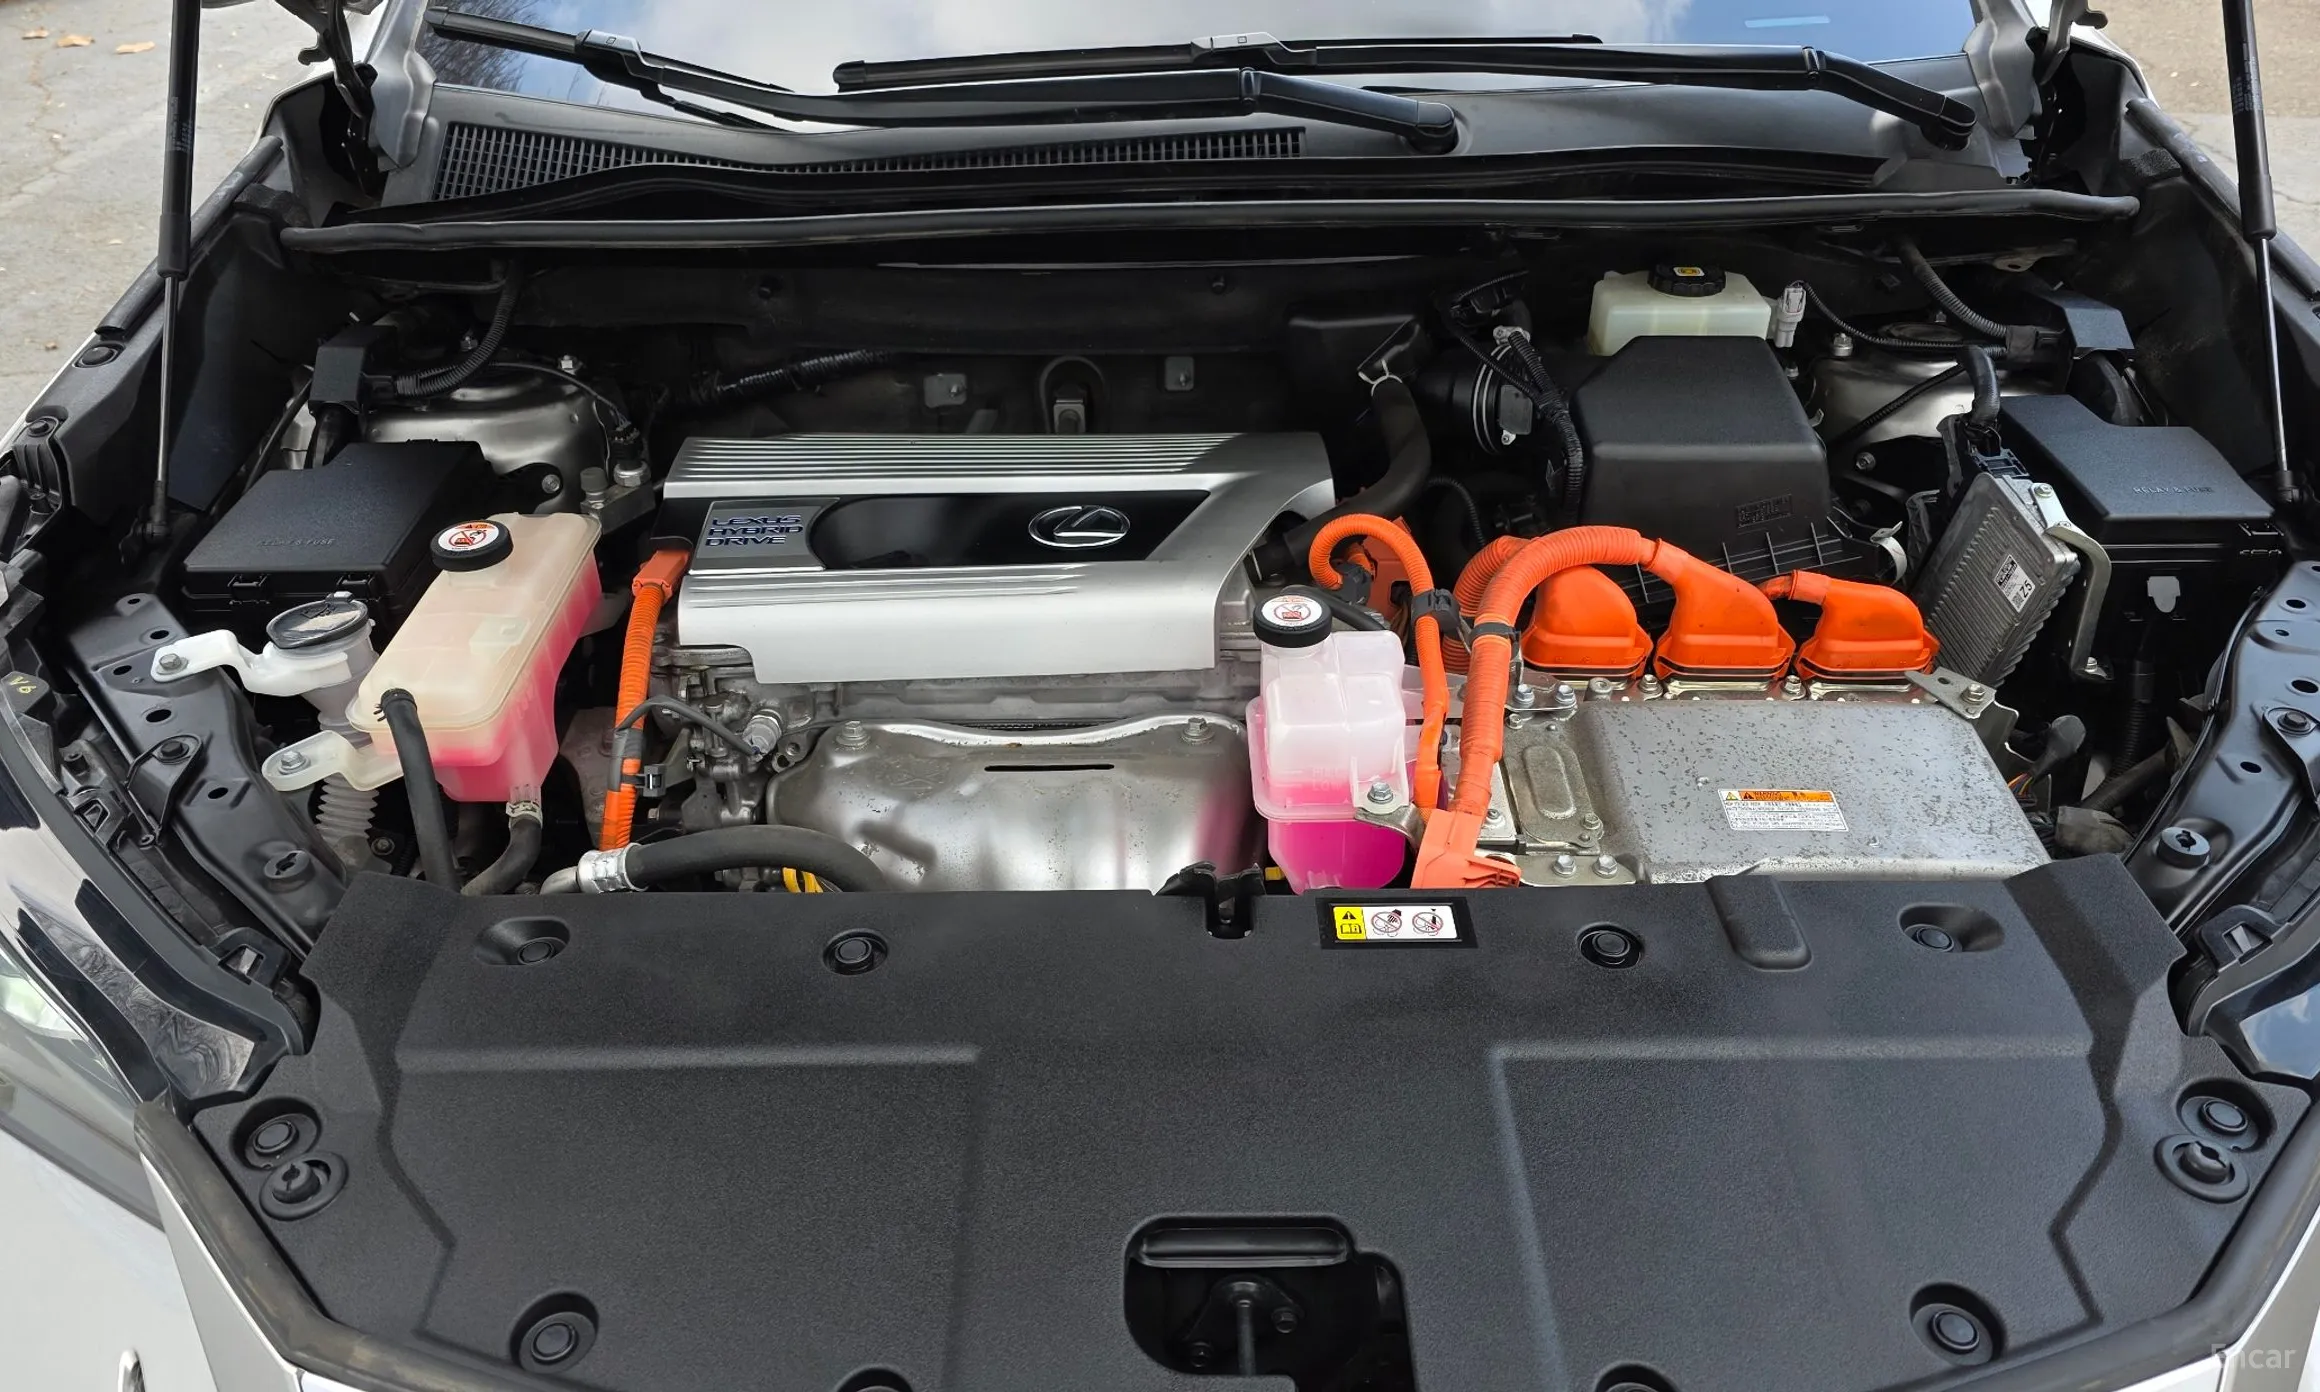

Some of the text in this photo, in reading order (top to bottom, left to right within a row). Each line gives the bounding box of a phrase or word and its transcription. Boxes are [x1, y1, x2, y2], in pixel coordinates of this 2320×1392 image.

[712, 515, 801, 526] LEXUS
[708, 525, 803, 536] HYBRID
[705, 535, 787, 546] DRIVE
